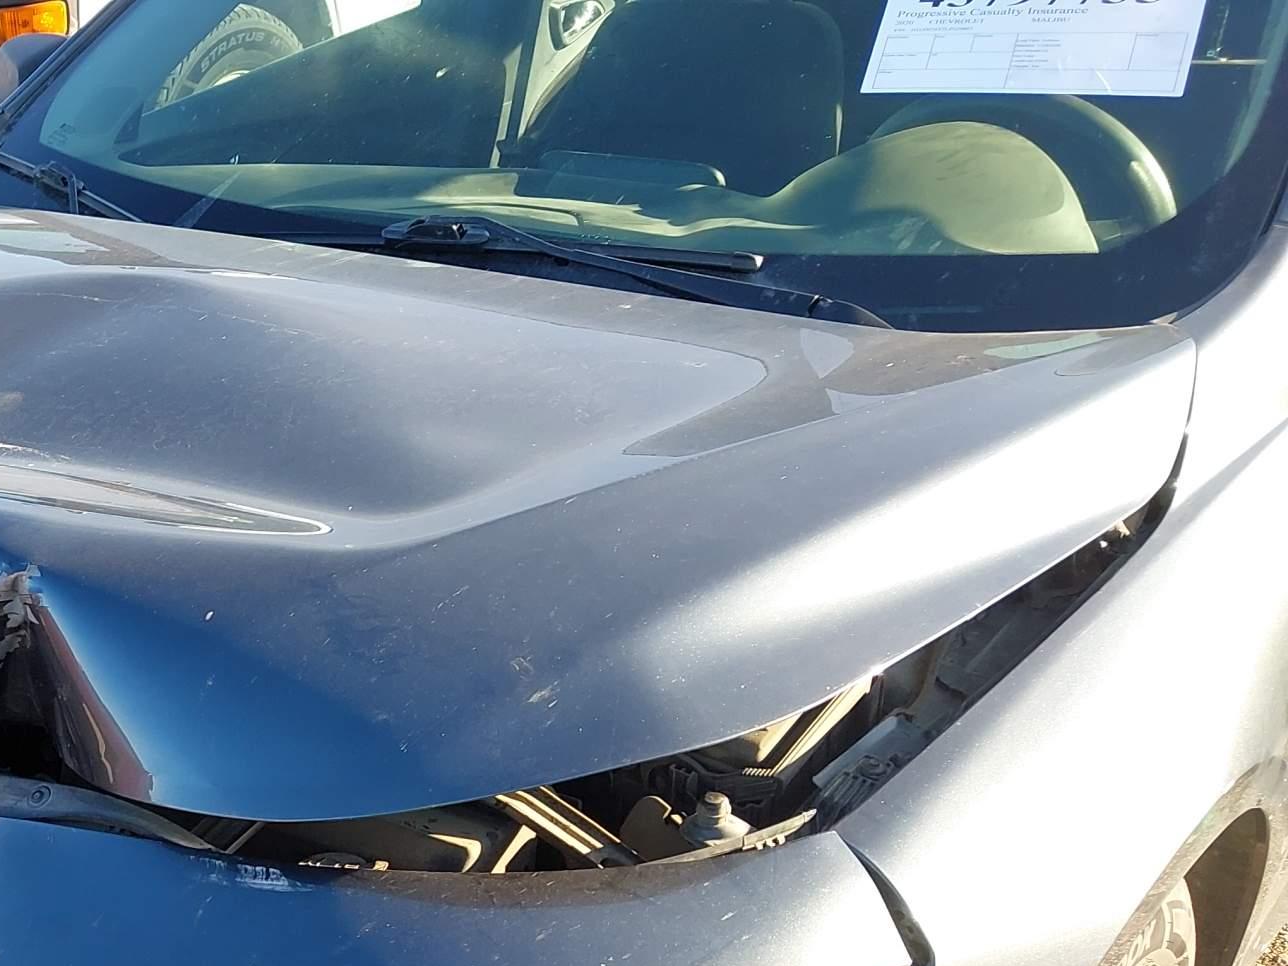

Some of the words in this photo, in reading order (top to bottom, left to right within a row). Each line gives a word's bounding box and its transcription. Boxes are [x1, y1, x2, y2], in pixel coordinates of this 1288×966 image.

[897, 8, 967, 18] Progressive
[970, 7, 1023, 16] Casualty
[1027, 7, 1089, 15] Insurance
[200, 32, 265, 72] STRATUS
